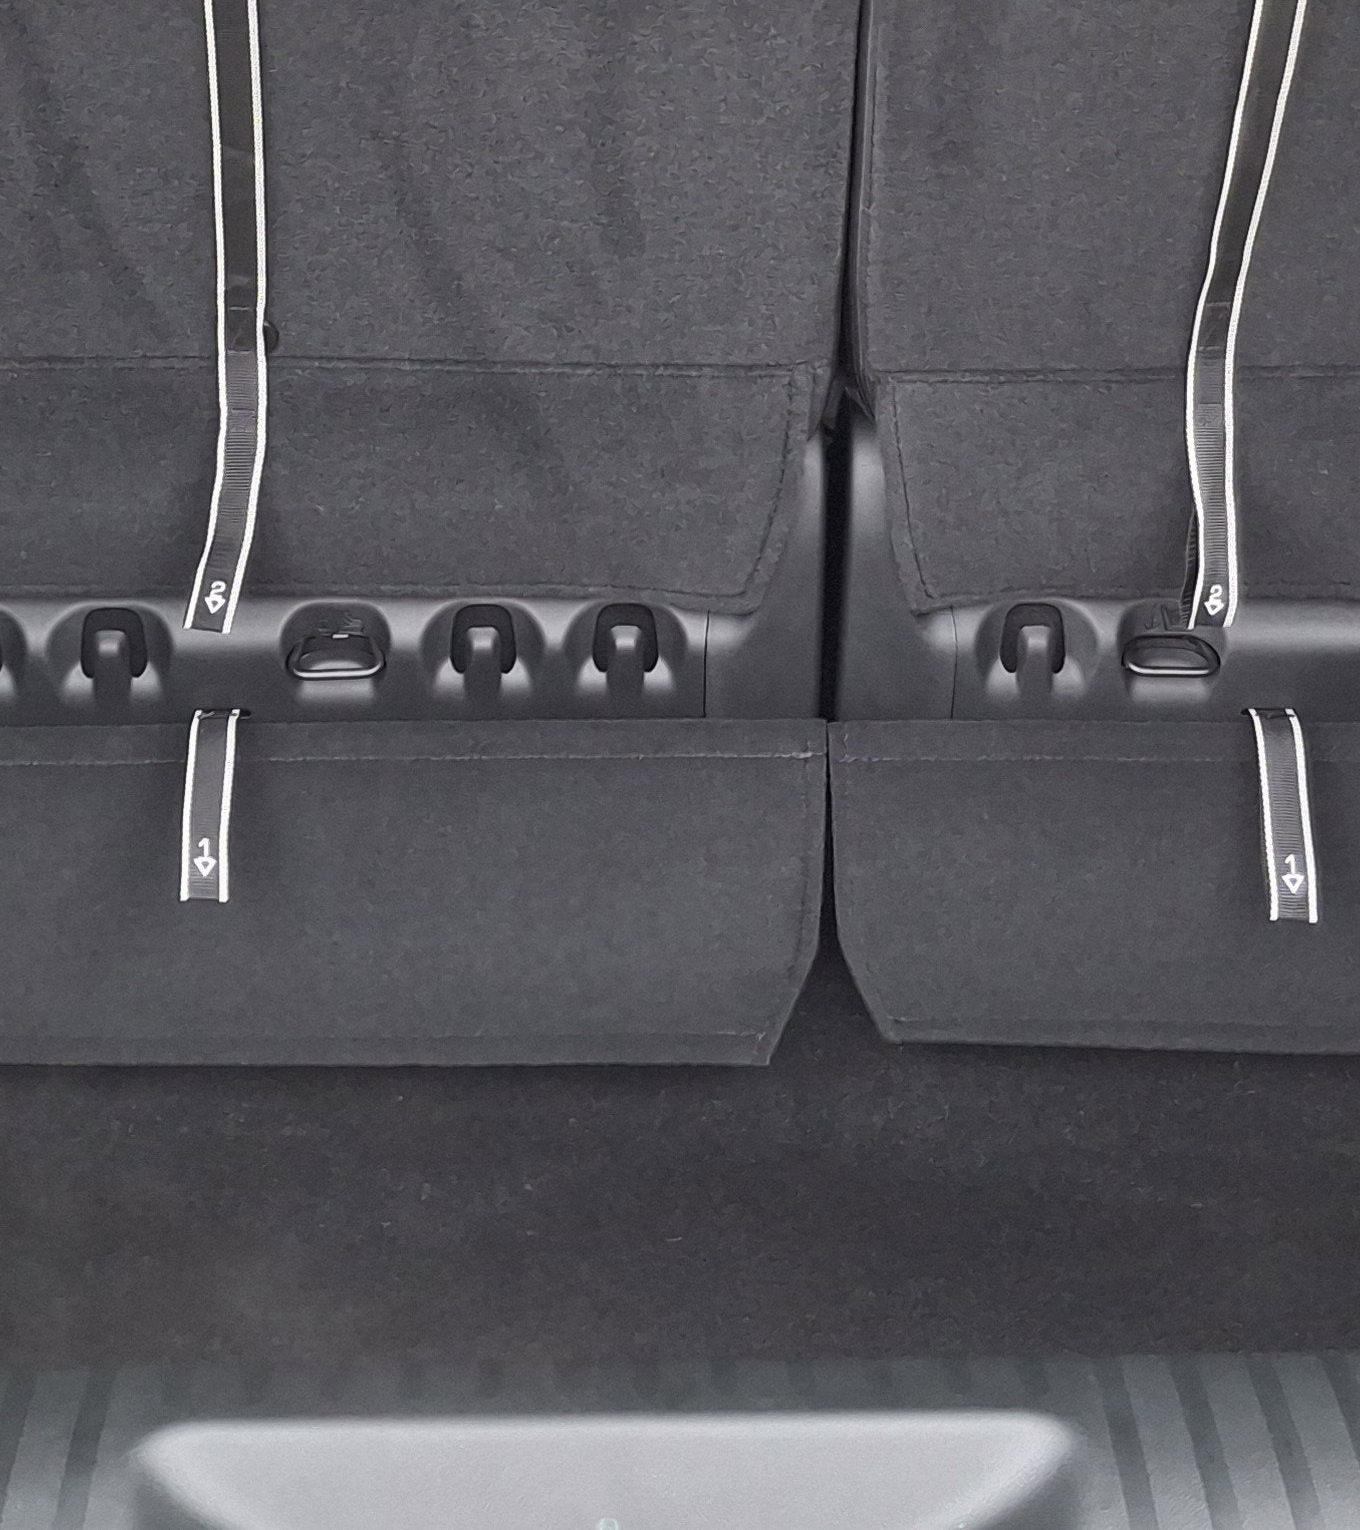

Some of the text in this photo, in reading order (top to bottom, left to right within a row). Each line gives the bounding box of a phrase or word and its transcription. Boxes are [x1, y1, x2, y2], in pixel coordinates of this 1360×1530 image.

[209, 580, 227, 597] 2
[1209, 584, 1223, 601] 2
[198, 837, 210, 857] 1
[1284, 853, 1296, 875] 1
